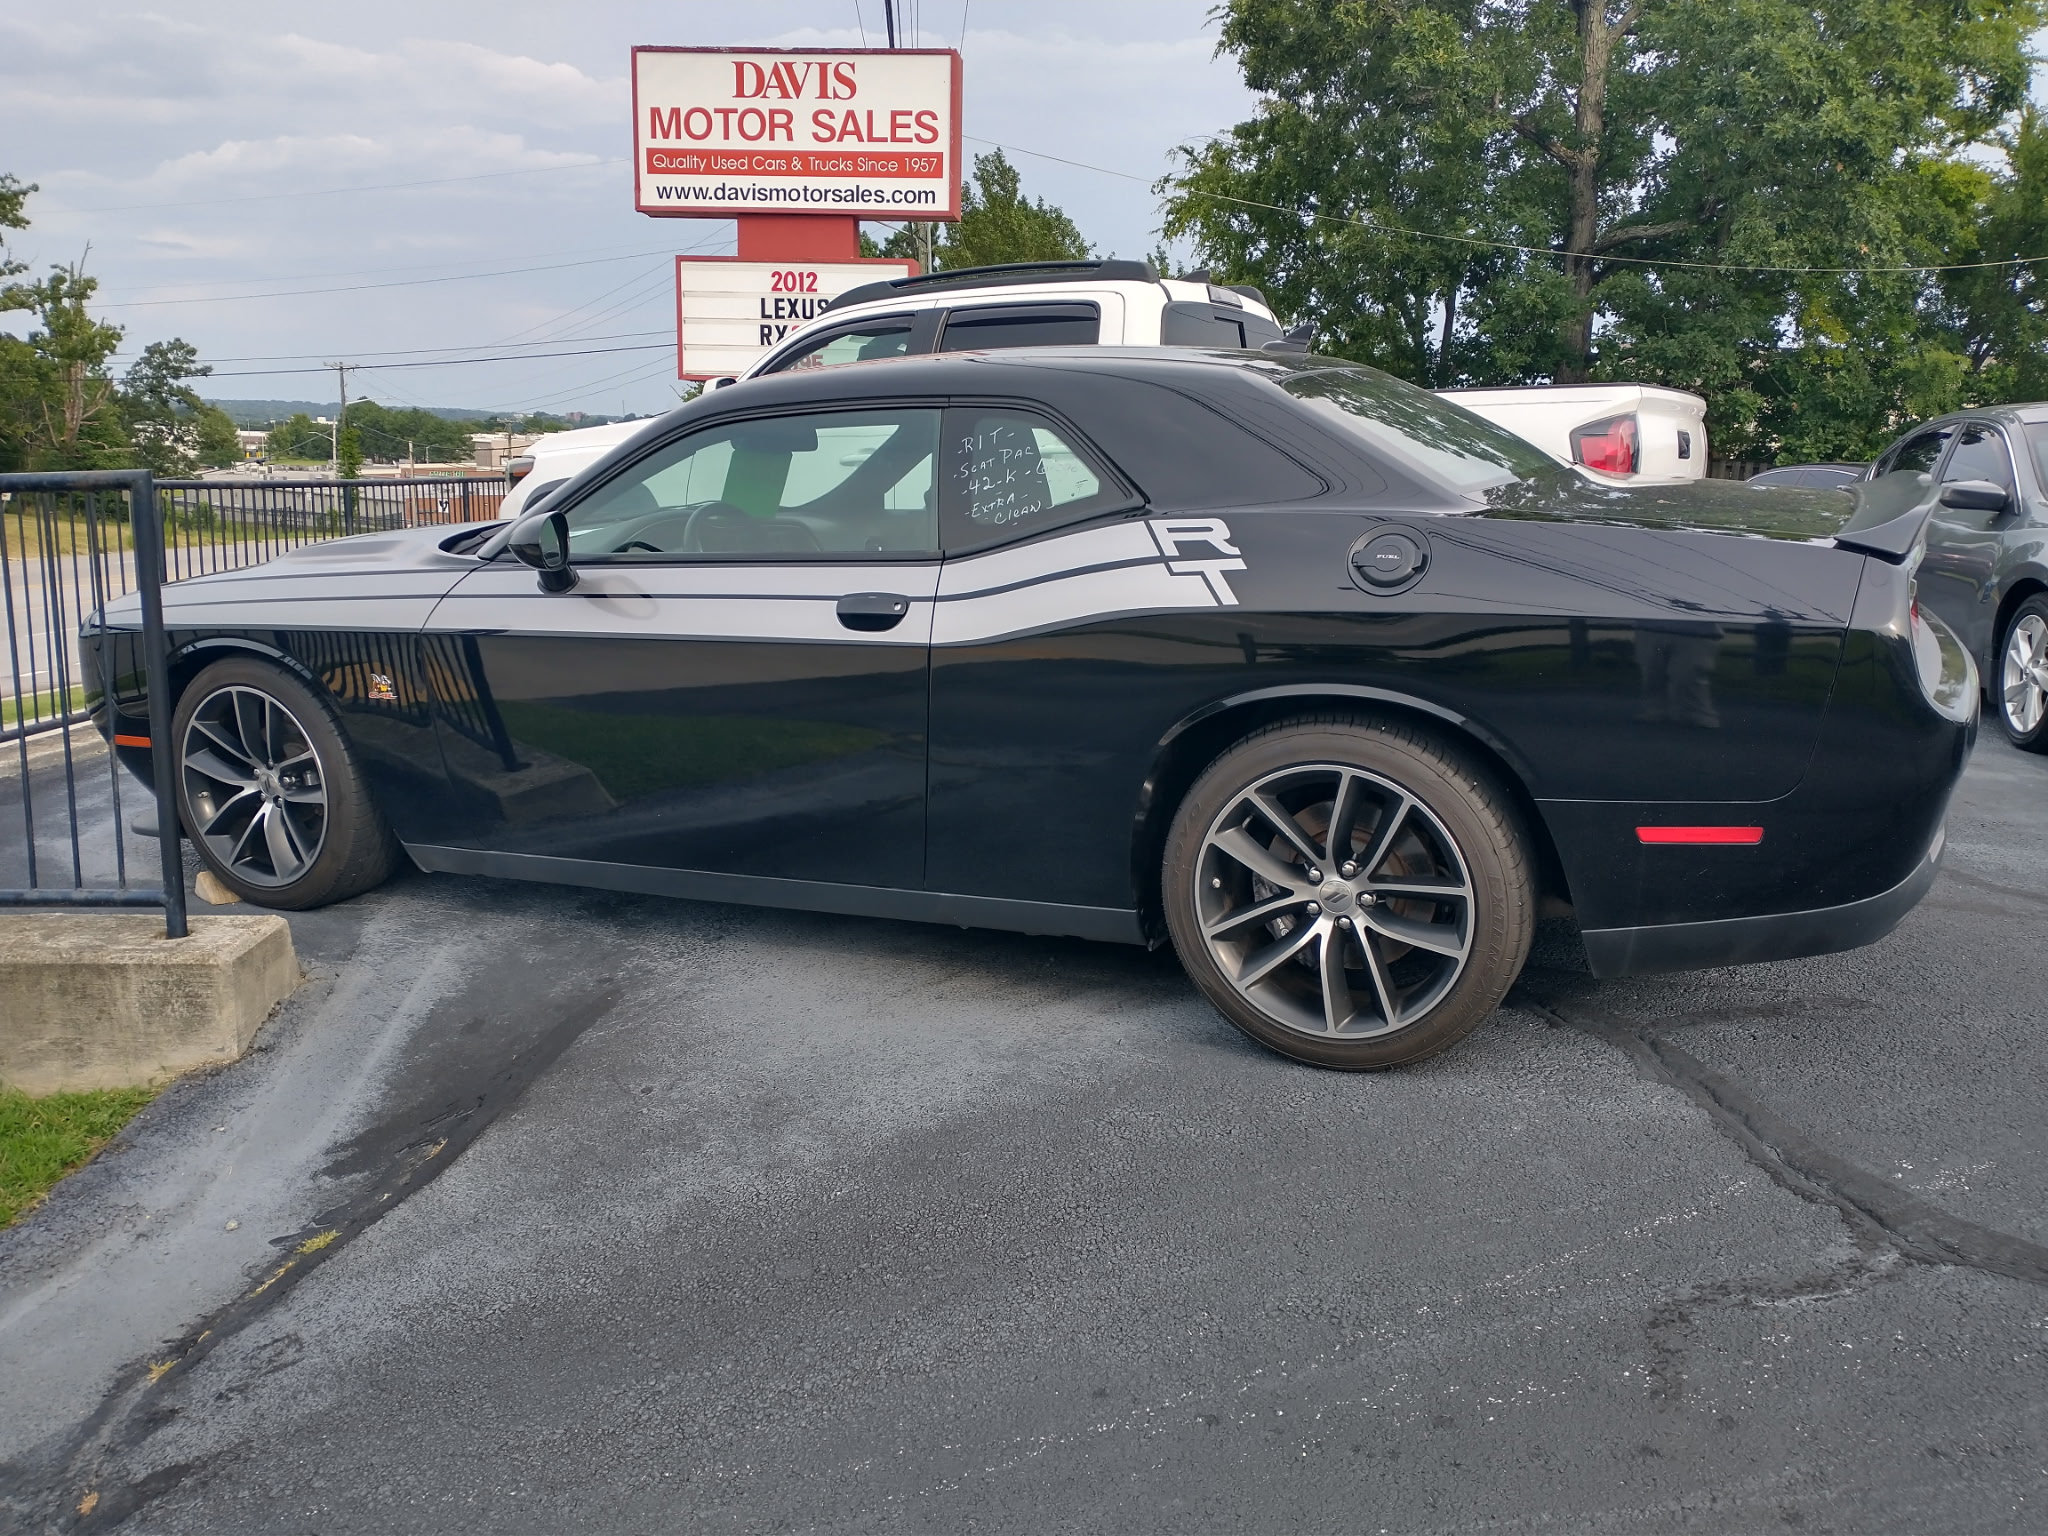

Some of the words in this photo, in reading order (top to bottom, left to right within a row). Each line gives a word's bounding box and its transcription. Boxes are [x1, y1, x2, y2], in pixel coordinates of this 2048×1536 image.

[732, 61, 857, 100] DAVIS
[650, 107, 794, 142] MOTOR
[811, 109, 939, 144] SALES
[652, 153, 707, 173] Quality
[711, 155, 749, 170] Used
[752, 155, 787, 171] Cars
[791, 156, 803, 171] &
[808, 157, 854, 172] Trucks
[857, 157, 899, 172] Since
[904, 157, 938, 173] 1957
[656, 182, 936, 205] www.davismotorsales.com
[771, 271, 818, 293] 2012
[760, 297, 829, 320] LEXUS
[971, 492, 1015, 518] EXTRA
